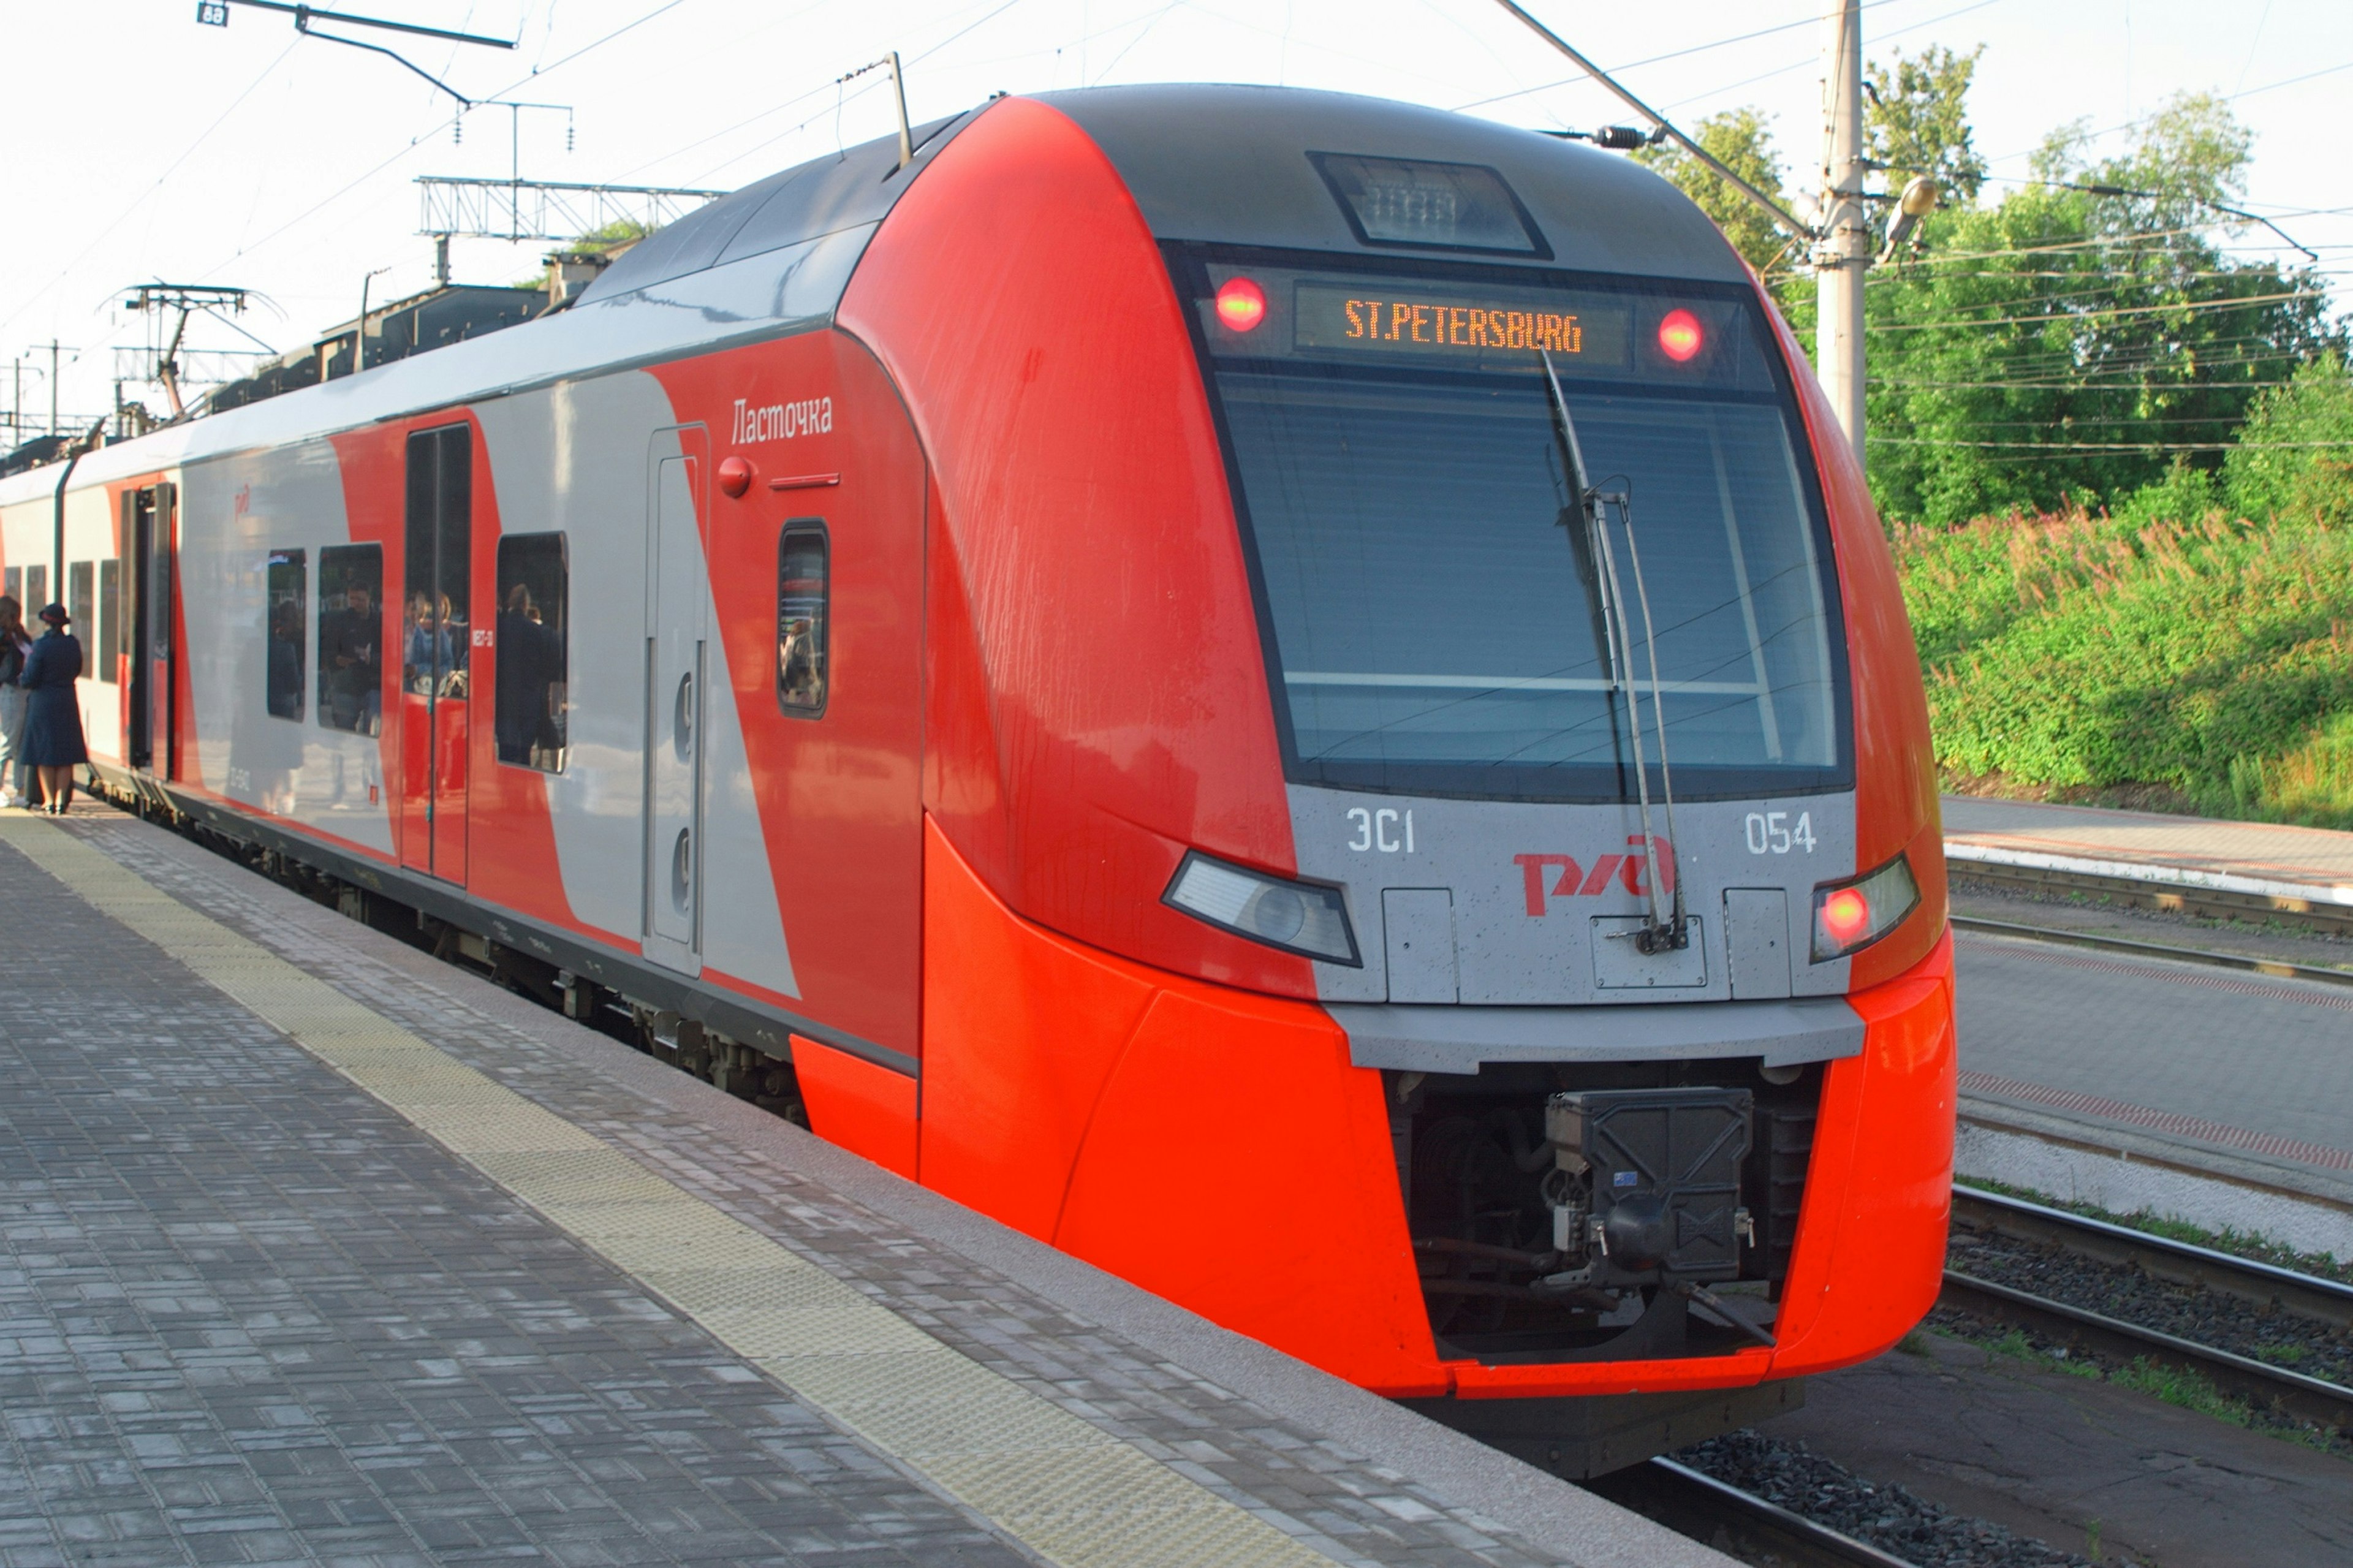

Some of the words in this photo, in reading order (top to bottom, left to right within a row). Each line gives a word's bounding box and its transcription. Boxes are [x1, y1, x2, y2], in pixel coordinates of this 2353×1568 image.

[1346, 300, 1581, 353] ST.PETERSBURG
[732, 396, 832, 445] Ласточка
[1745, 811, 1817, 854] 054
